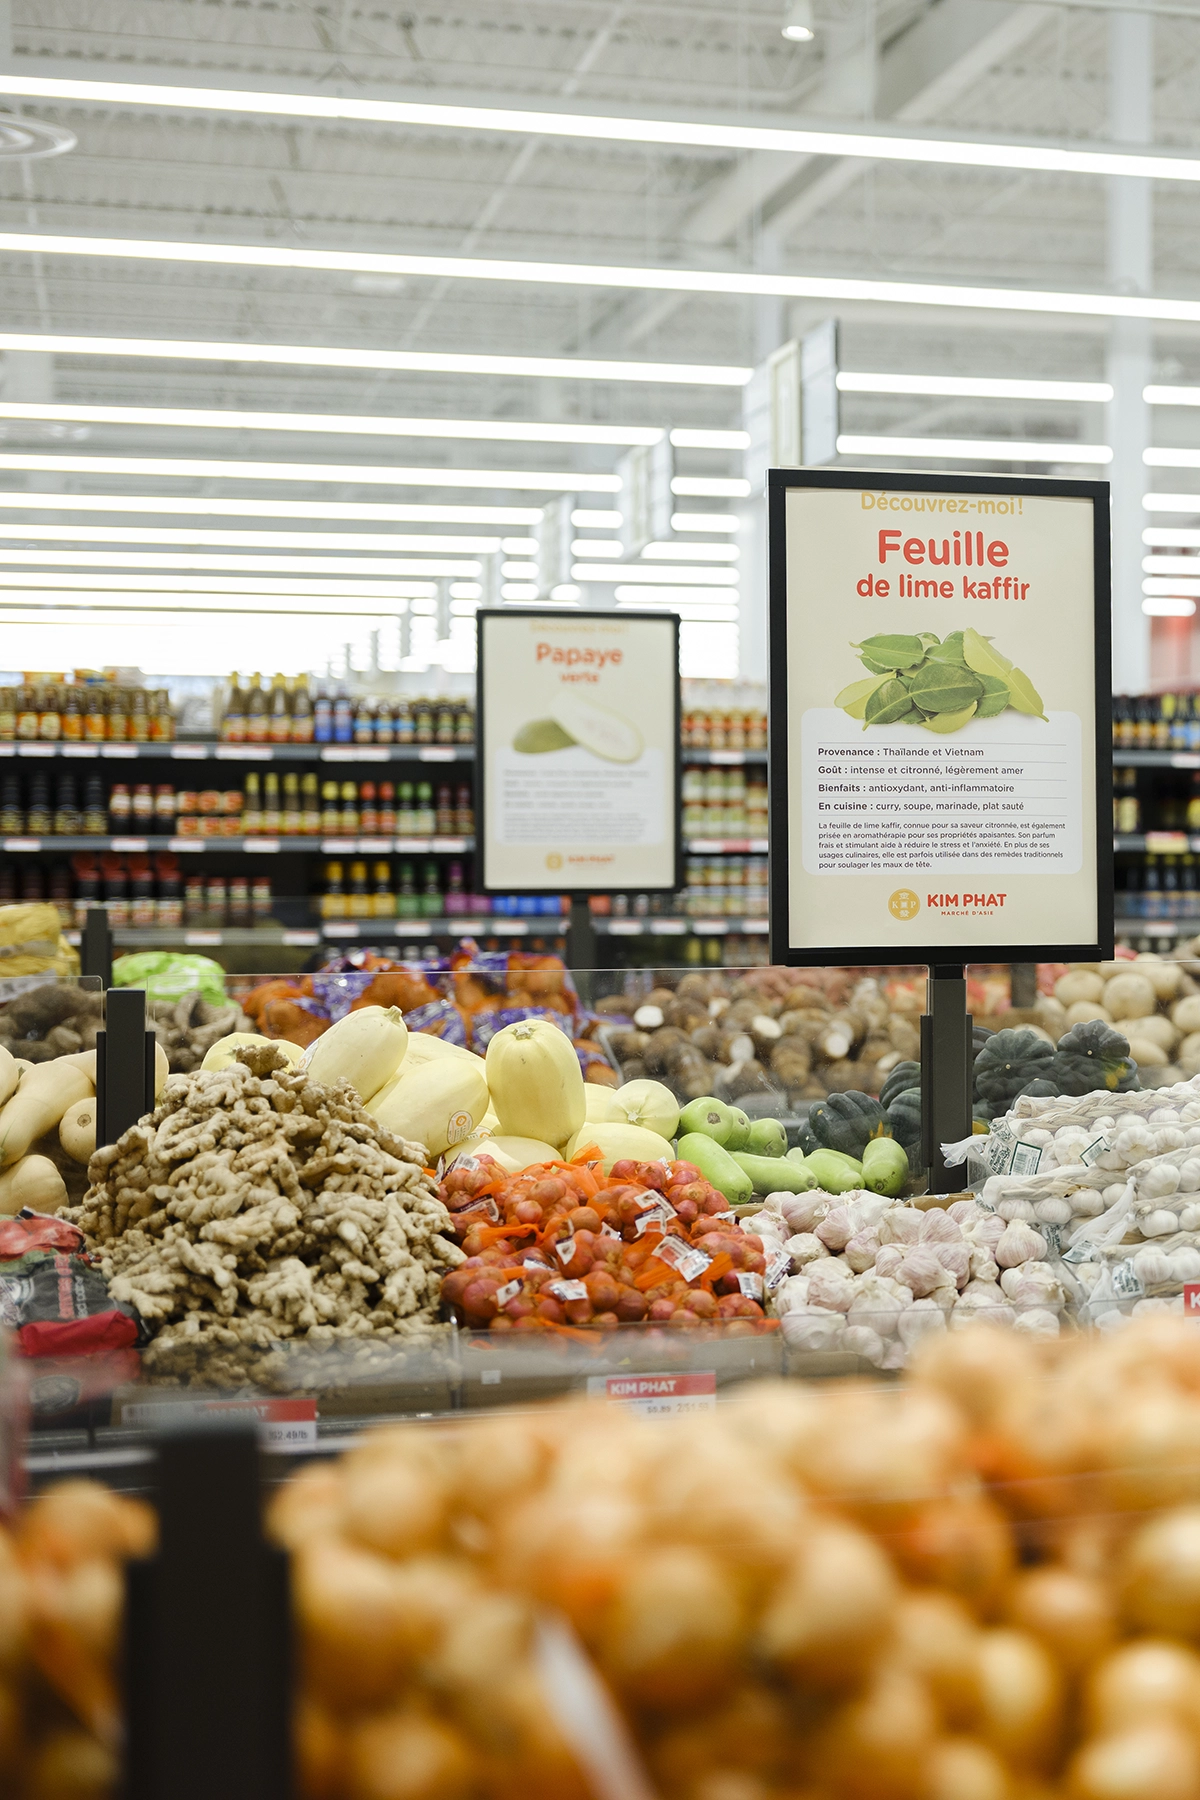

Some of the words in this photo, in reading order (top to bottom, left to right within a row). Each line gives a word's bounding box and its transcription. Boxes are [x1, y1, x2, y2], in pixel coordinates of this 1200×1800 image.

[878, 529, 1009, 568] Feuille
[856, 573, 890, 598] de
[899, 573, 954, 599] lime
[963, 575, 1030, 601] kaffir
[536, 643, 623, 669] Papaye
[818, 747, 874, 756] Provenance
[883, 748, 930, 756] Thaïlande
[932, 748, 942, 756] et
[944, 748, 984, 756] Vietnam
[818, 765, 842, 774] Goût
[850, 765, 885, 774] intense
[887, 766, 898, 774] et
[900, 765, 943, 775] citronné,
[945, 765, 999, 776] légèrement
[818, 783, 860, 792] Bienfaits
[868, 784, 927, 794] antioxydant,
[930, 783, 1015, 792] anti-inflammatoire
[818, 802, 831, 810] En
[833, 802, 868, 810] cuisine
[875, 803, 901, 812] curry,
[903, 803, 934, 811] soupe,
[936, 801, 980, 811] marinade,
[982, 802, 999, 811] plat
[1001, 802, 1024, 810] sauté
[881, 822, 902, 830] kaffir,
[1031, 822, 1066, 830] également
[818, 832, 841, 840] prisée
[853, 832, 906, 840] aromathérapie
[940, 831, 977, 839] propriétés
[978, 831, 1017, 839] apaisantes.
[1018, 831, 1031, 839] Son
[904, 841, 930, 849] réduire
[1014, 841, 1028, 849] plus
[845, 851, 881, 859] culinaires,
[909, 851, 934, 859] parfois
[837, 861, 869, 869] soulager
[927, 894, 959, 908] KIM
[963, 893, 1007, 907] PHAT
[610, 1382, 638, 1395] KIM
[640, 1380, 677, 1393] PHAT
